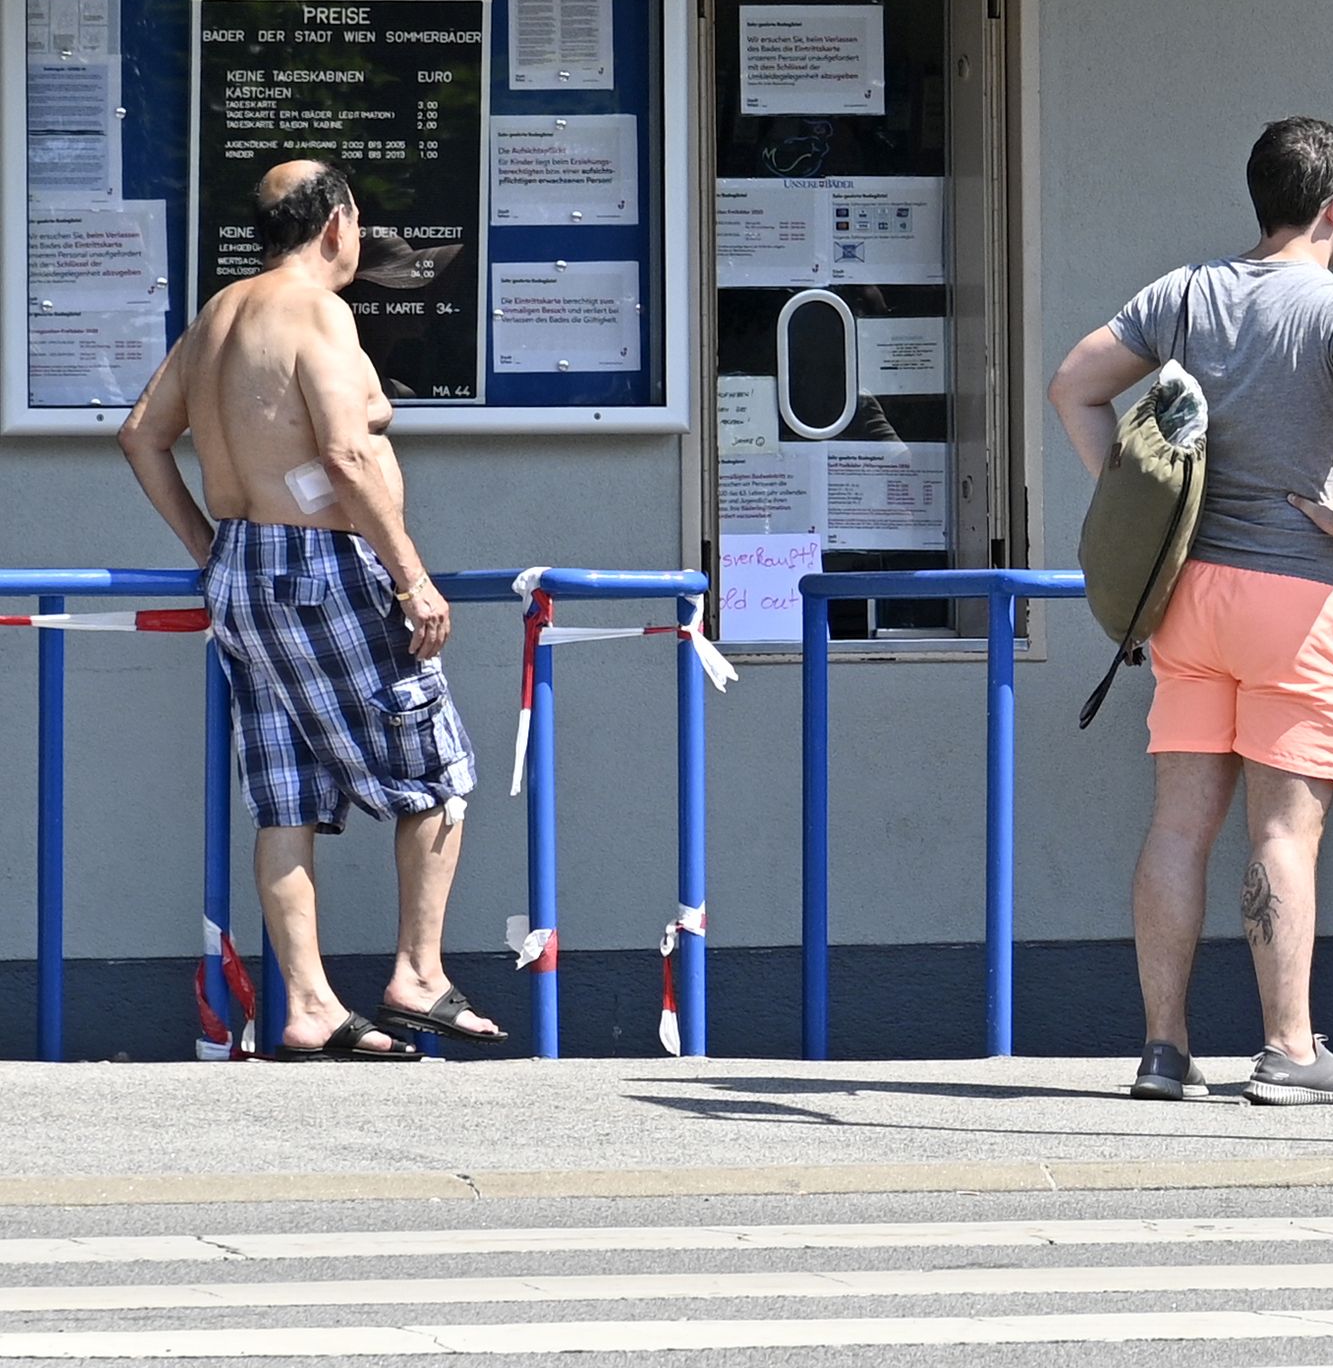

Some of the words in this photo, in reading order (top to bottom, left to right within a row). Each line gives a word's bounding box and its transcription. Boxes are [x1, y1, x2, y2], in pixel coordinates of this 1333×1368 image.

[303, 7, 371, 25] PREISE
[202, 27, 245, 43] BÄDER
[257, 31, 285, 42] DER
[294, 31, 333, 42] STADT
[343, 31, 376, 43] WIEN
[385, 29, 482, 43] SOMMERBÄDER
[226, 70, 265, 83] KEINE
[272, 70, 365, 83] TAGESKABINEN
[417, 71, 453, 83] EURO
[225, 83, 292, 99] KÄSTCHEN
[225, 100, 278, 109] TAGESKARTE
[225, 110, 275, 120] TAGESKARTE
[225, 120, 275, 130] TAGESKARTE
[224, 150, 255, 159] KINDER
[219, 226, 255, 239] KEINE
[372, 226, 398, 239] DER
[403, 226, 464, 239] BADEZEIT
[501, 297, 513, 305] Die
[514, 297, 562, 305] Eintrittskarte
[352, 302, 380, 314] TIGE
[385, 302, 425, 314] KARTE
[432, 385, 451, 397] MA
[454, 385, 471, 397] 44
[760, 587, 800, 610] out
